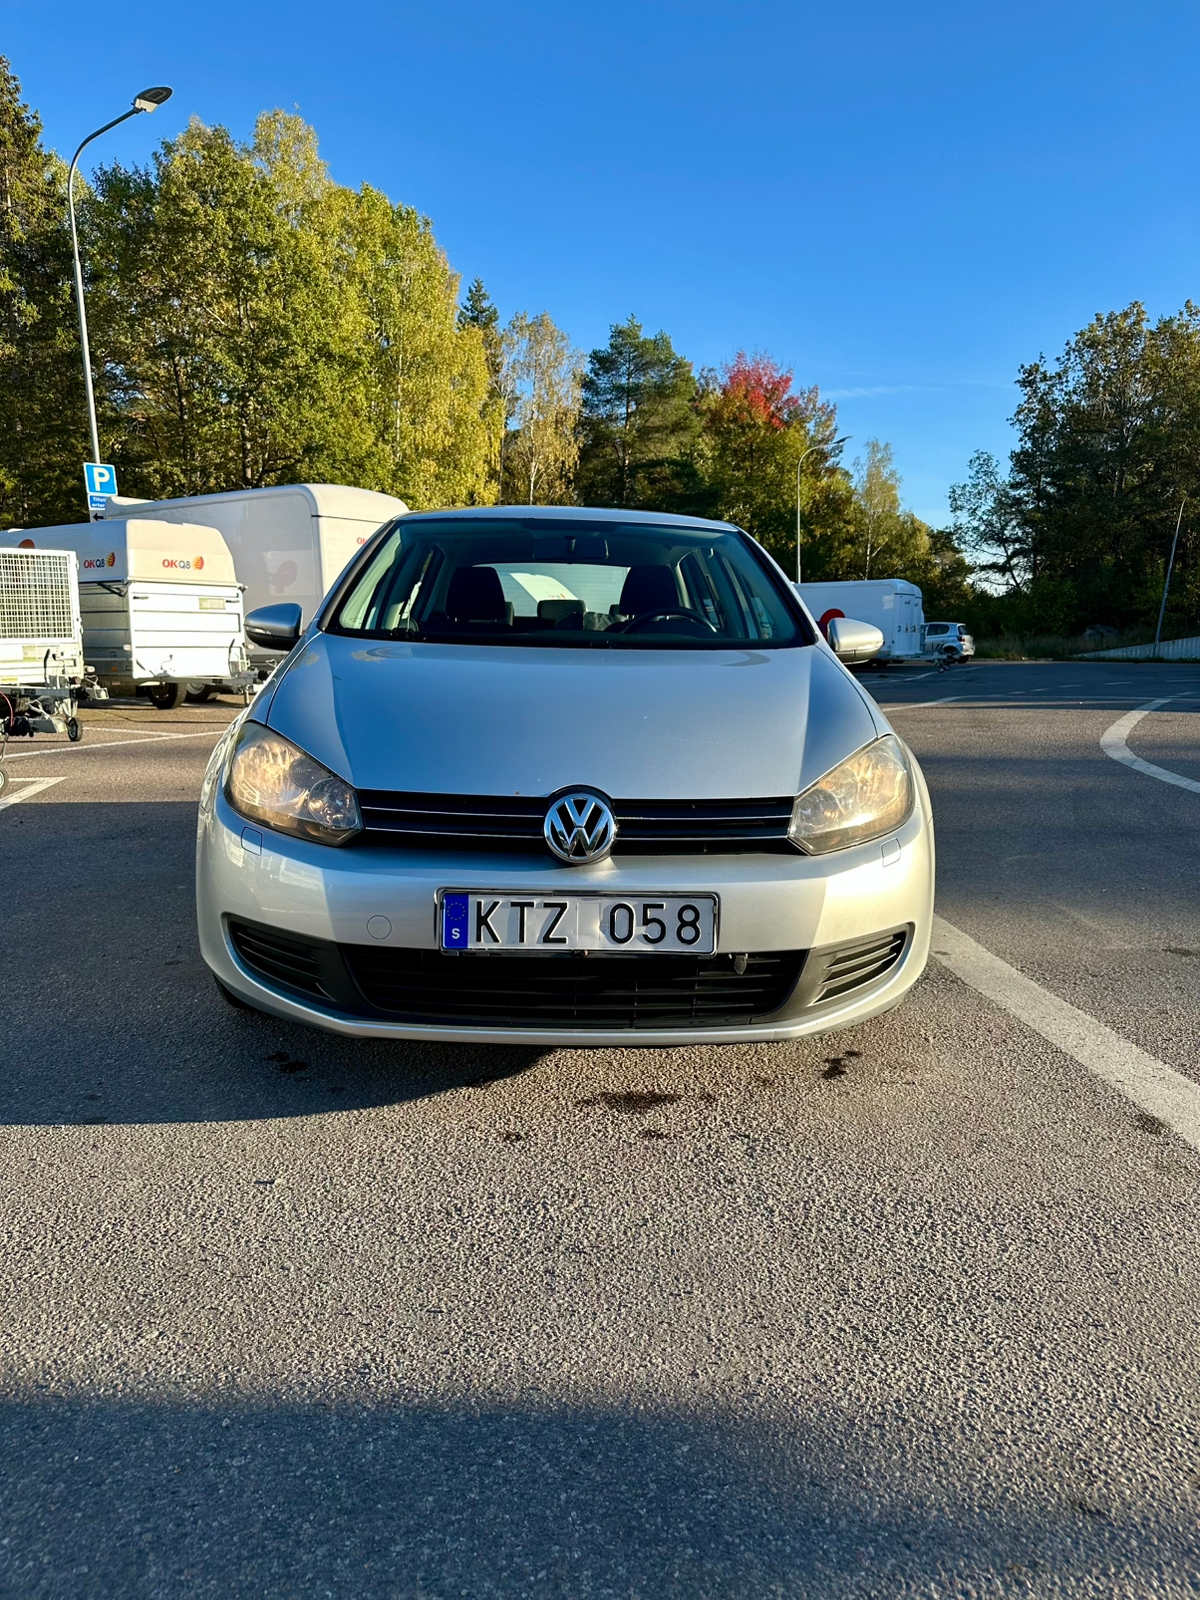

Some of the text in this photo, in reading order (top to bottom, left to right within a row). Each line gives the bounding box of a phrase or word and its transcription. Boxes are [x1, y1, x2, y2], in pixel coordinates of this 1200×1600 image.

[92, 466, 110, 492] P
[83, 559, 106, 569] OKQ8
[162, 558, 191, 570] OKQ8
[475, 900, 702, 946] KTZ 058
[451, 927, 461, 940] S
